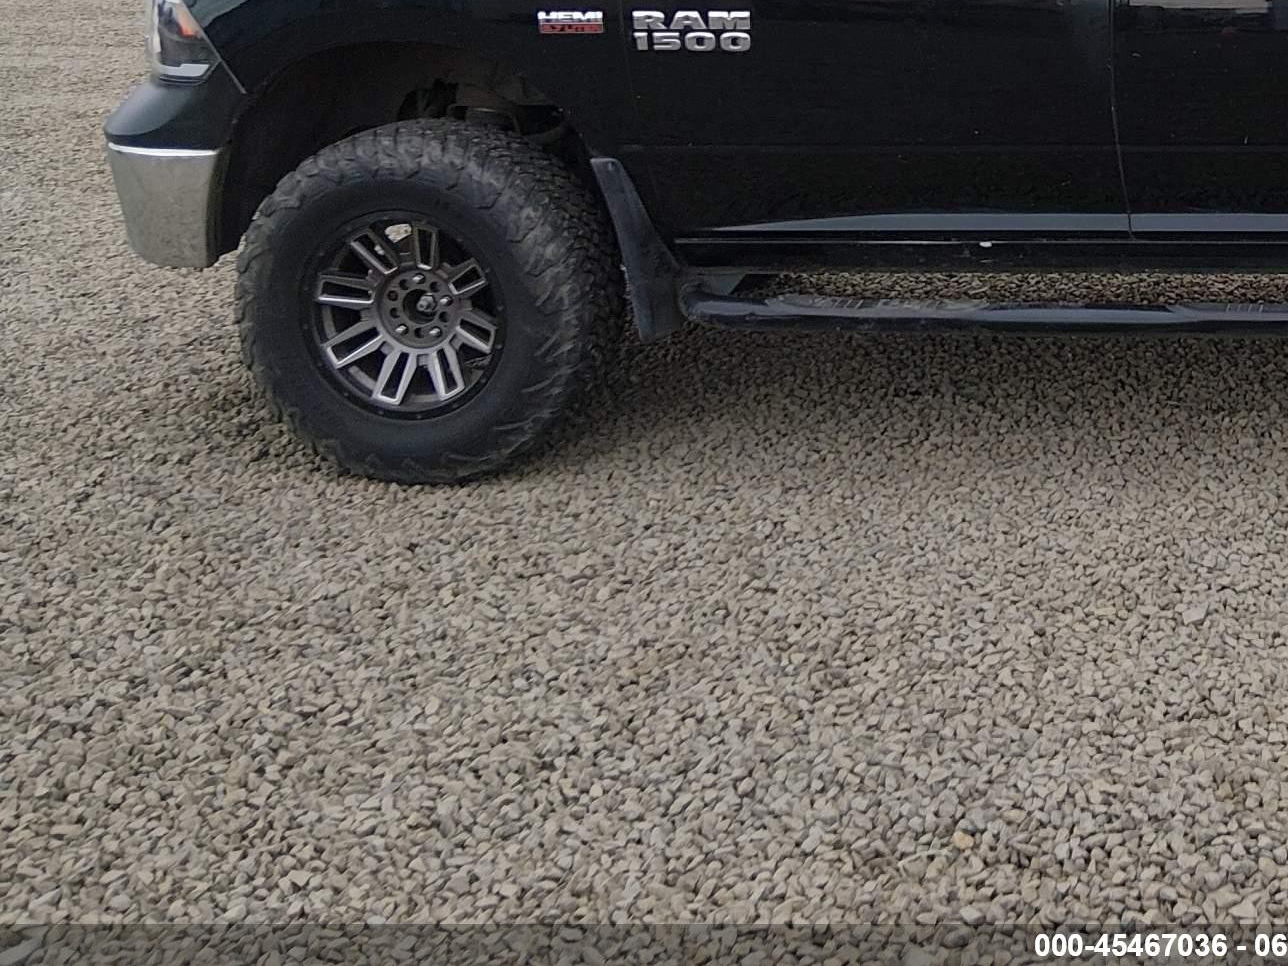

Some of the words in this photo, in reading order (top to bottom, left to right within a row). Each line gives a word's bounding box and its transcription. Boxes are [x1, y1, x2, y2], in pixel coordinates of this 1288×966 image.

[537, 11, 603, 22] HEMI
[632, 10, 751, 30] RAM
[633, 31, 751, 52] 1500
